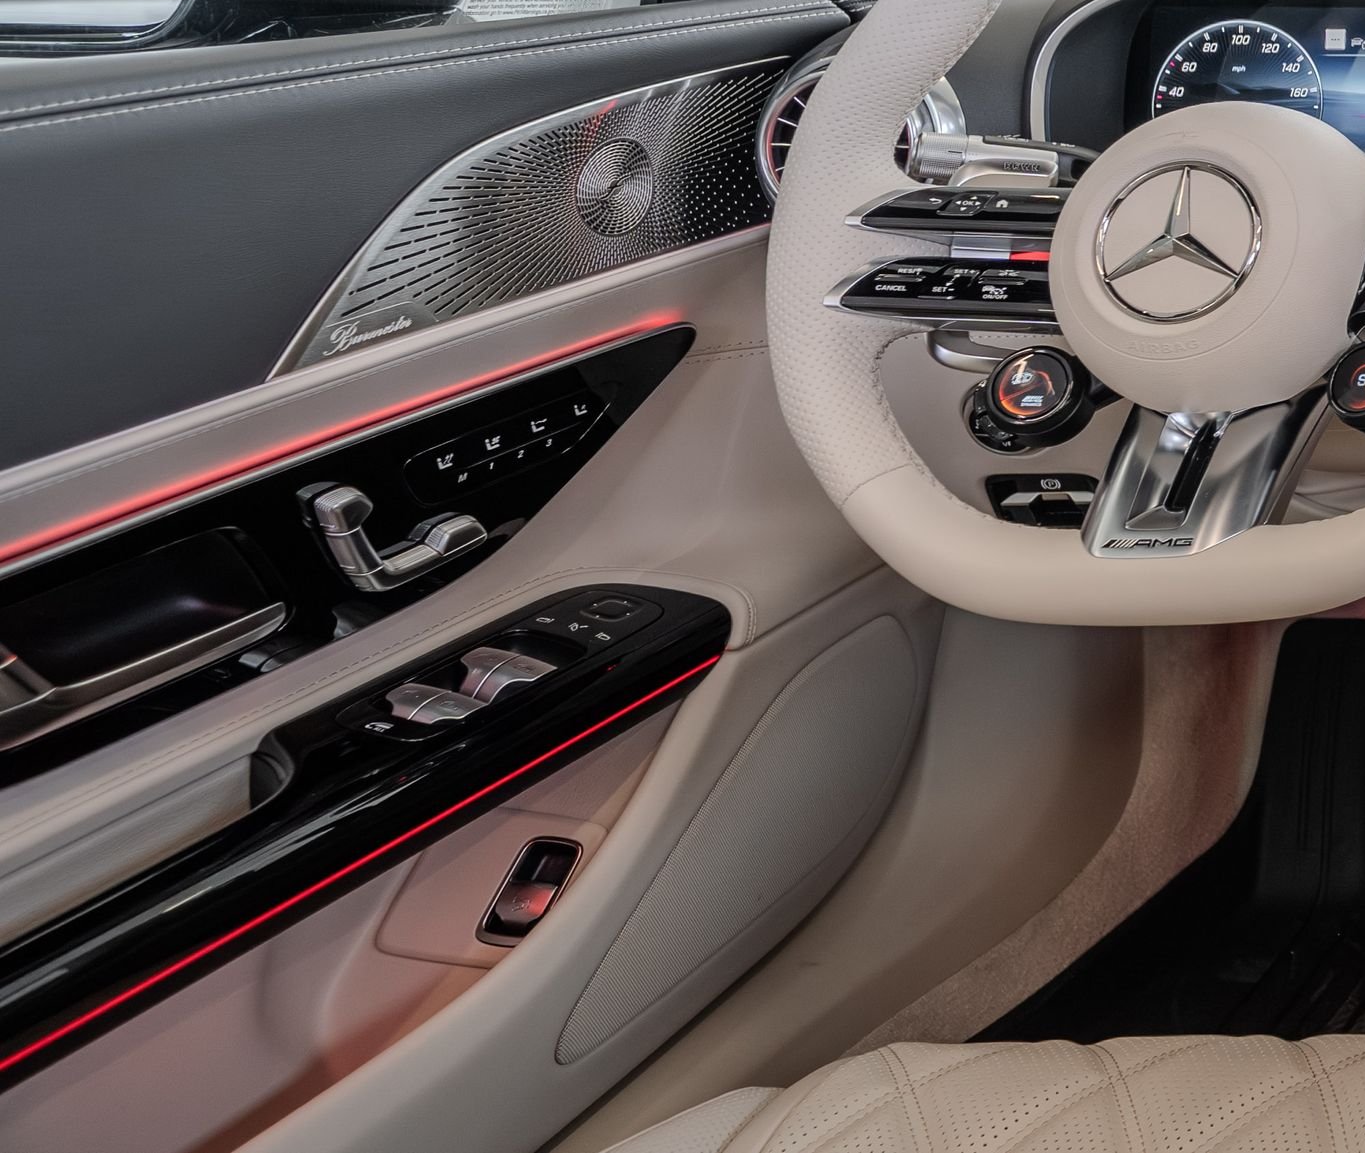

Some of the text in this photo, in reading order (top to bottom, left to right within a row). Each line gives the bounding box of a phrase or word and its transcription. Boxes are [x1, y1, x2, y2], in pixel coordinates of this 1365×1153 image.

[1202, 34, 1280, 54] 80 100 120
[1180, 61, 1300, 74] 60 mph 140
[1168, 86, 1308, 98] 40 160
[1003, 161, 1040, 173] DOWN
[962, 198, 974, 206] OK
[874, 284, 908, 292] CANCEL
[322, 314, 413, 356] Burmester
[1126, 340, 1202, 353] AIRBAG
[457, 438, 553, 484] M 1 2 3
[1134, 536, 1196, 548] AMG
